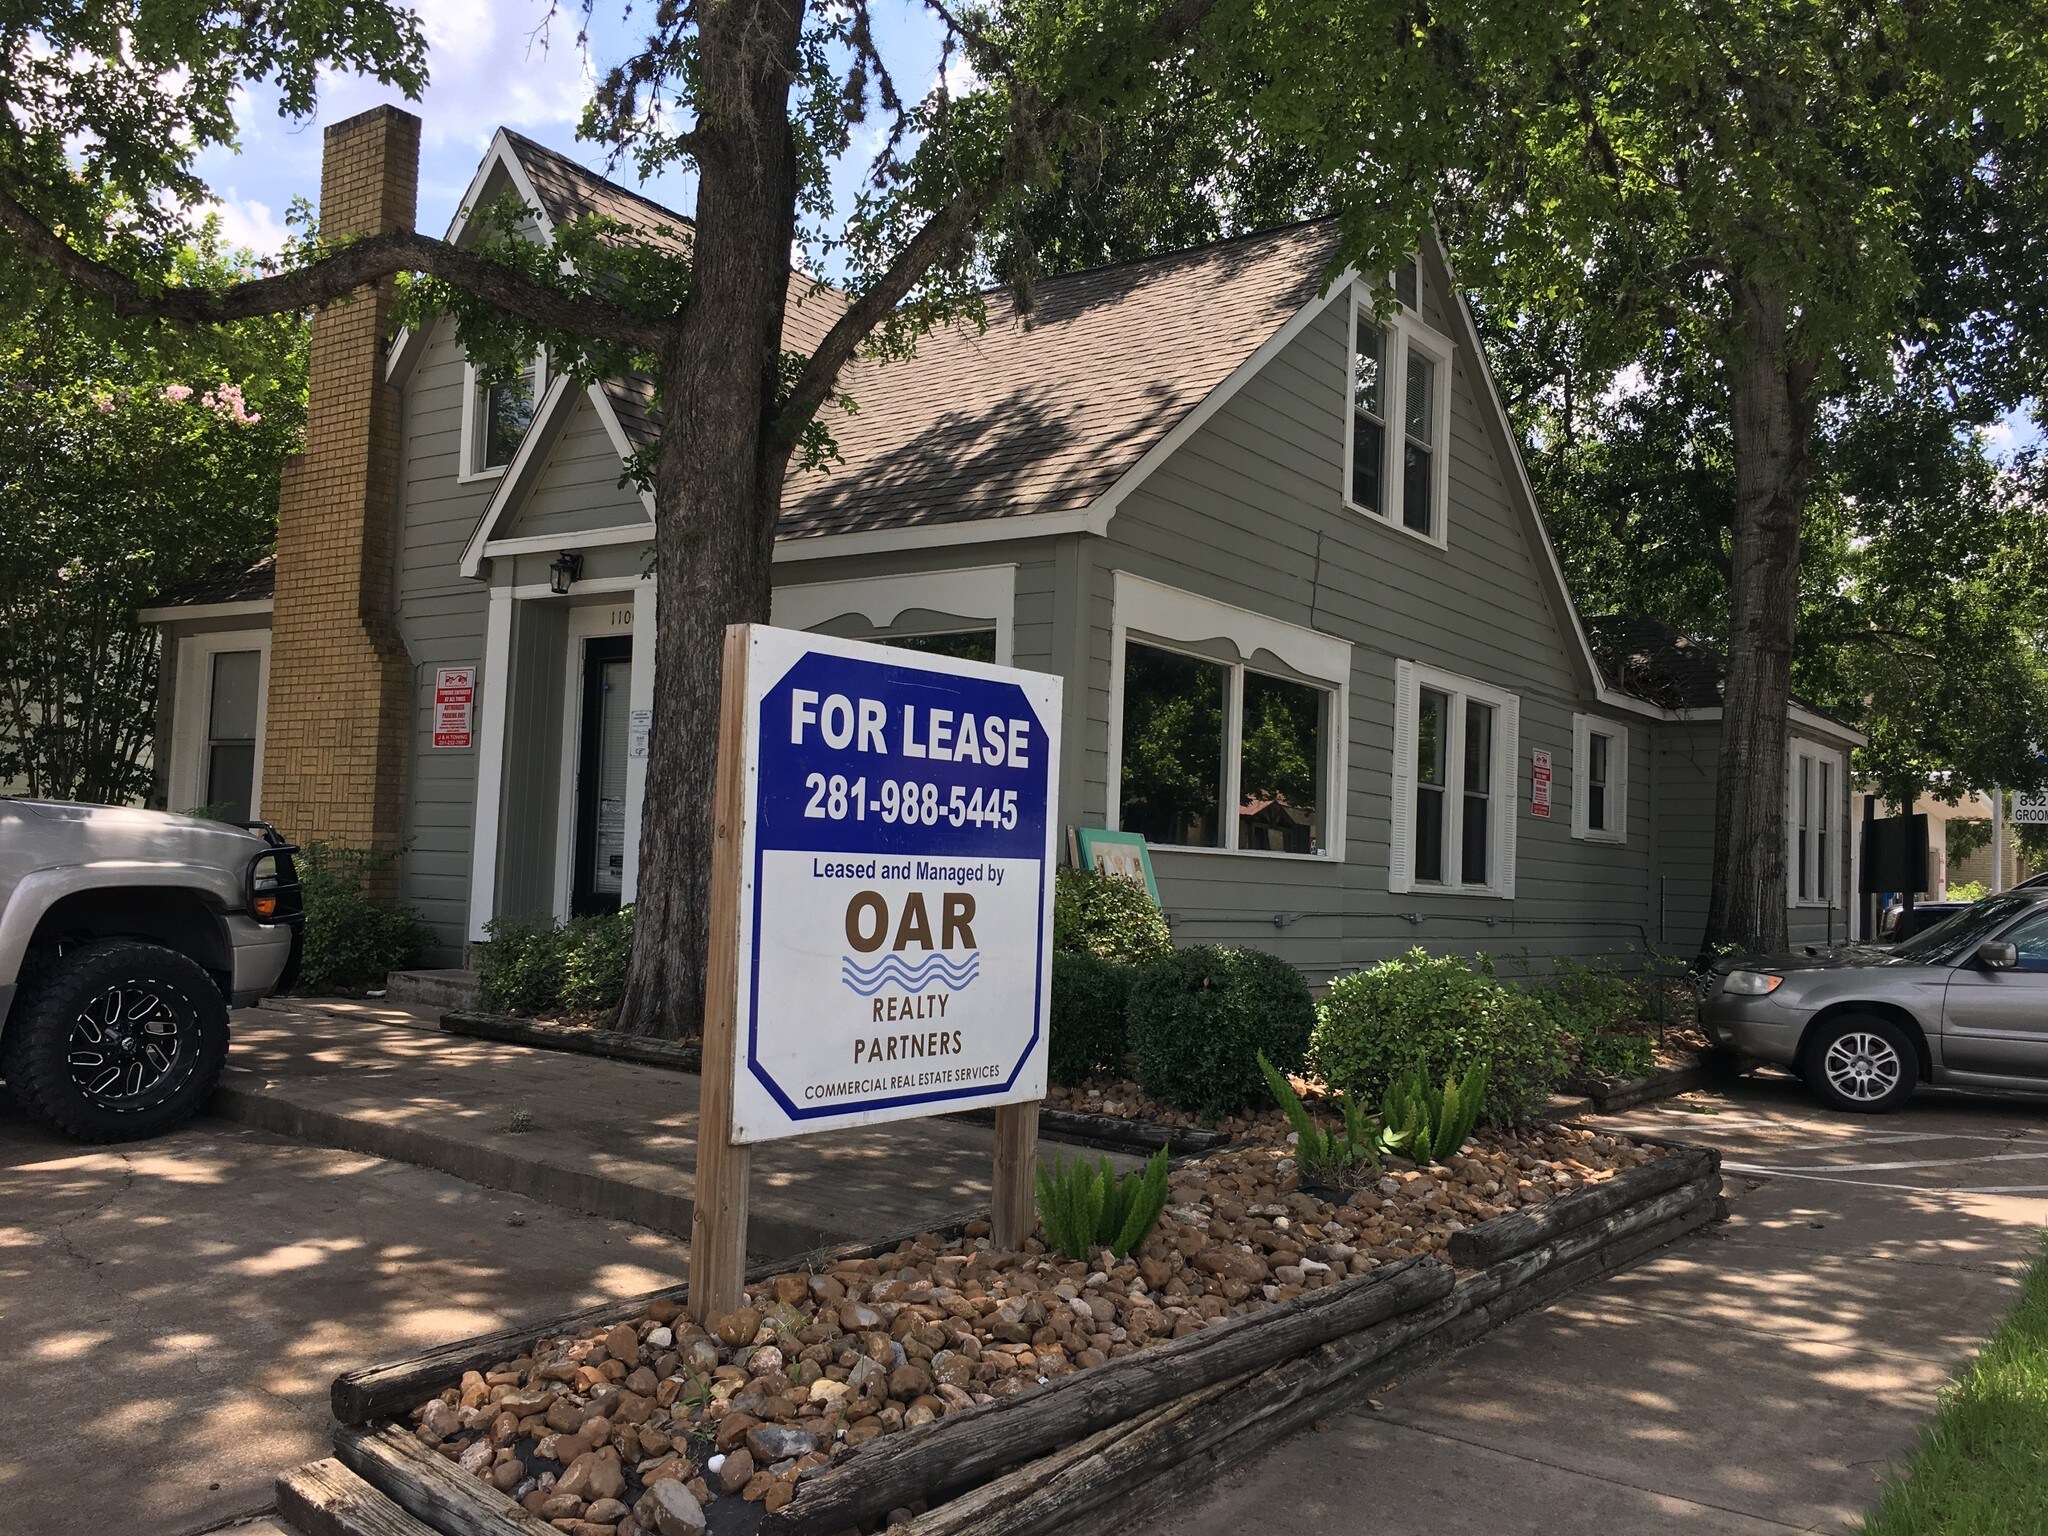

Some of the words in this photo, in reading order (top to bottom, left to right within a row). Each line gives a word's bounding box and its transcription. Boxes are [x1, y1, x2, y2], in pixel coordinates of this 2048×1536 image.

[791, 688, 888, 754] FOR
[903, 704, 1030, 768] LEASE
[804, 772, 1018, 830] 281-988-5445
[813, 858, 876, 879] Leased
[881, 861, 911, 880] and
[916, 861, 983, 885] Managed
[987, 864, 1005, 886] by
[845, 890, 978, 953] OAR
[872, 994, 949, 1022] REALTY
[854, 1030, 962, 1064] PARTNERS
[804, 1077, 888, 1100] COMMERCIAL
[890, 1074, 916, 1090] REAL
[918, 1070, 953, 1086] ESTATE
[955, 1064, 1001, 1083] SERVICES
